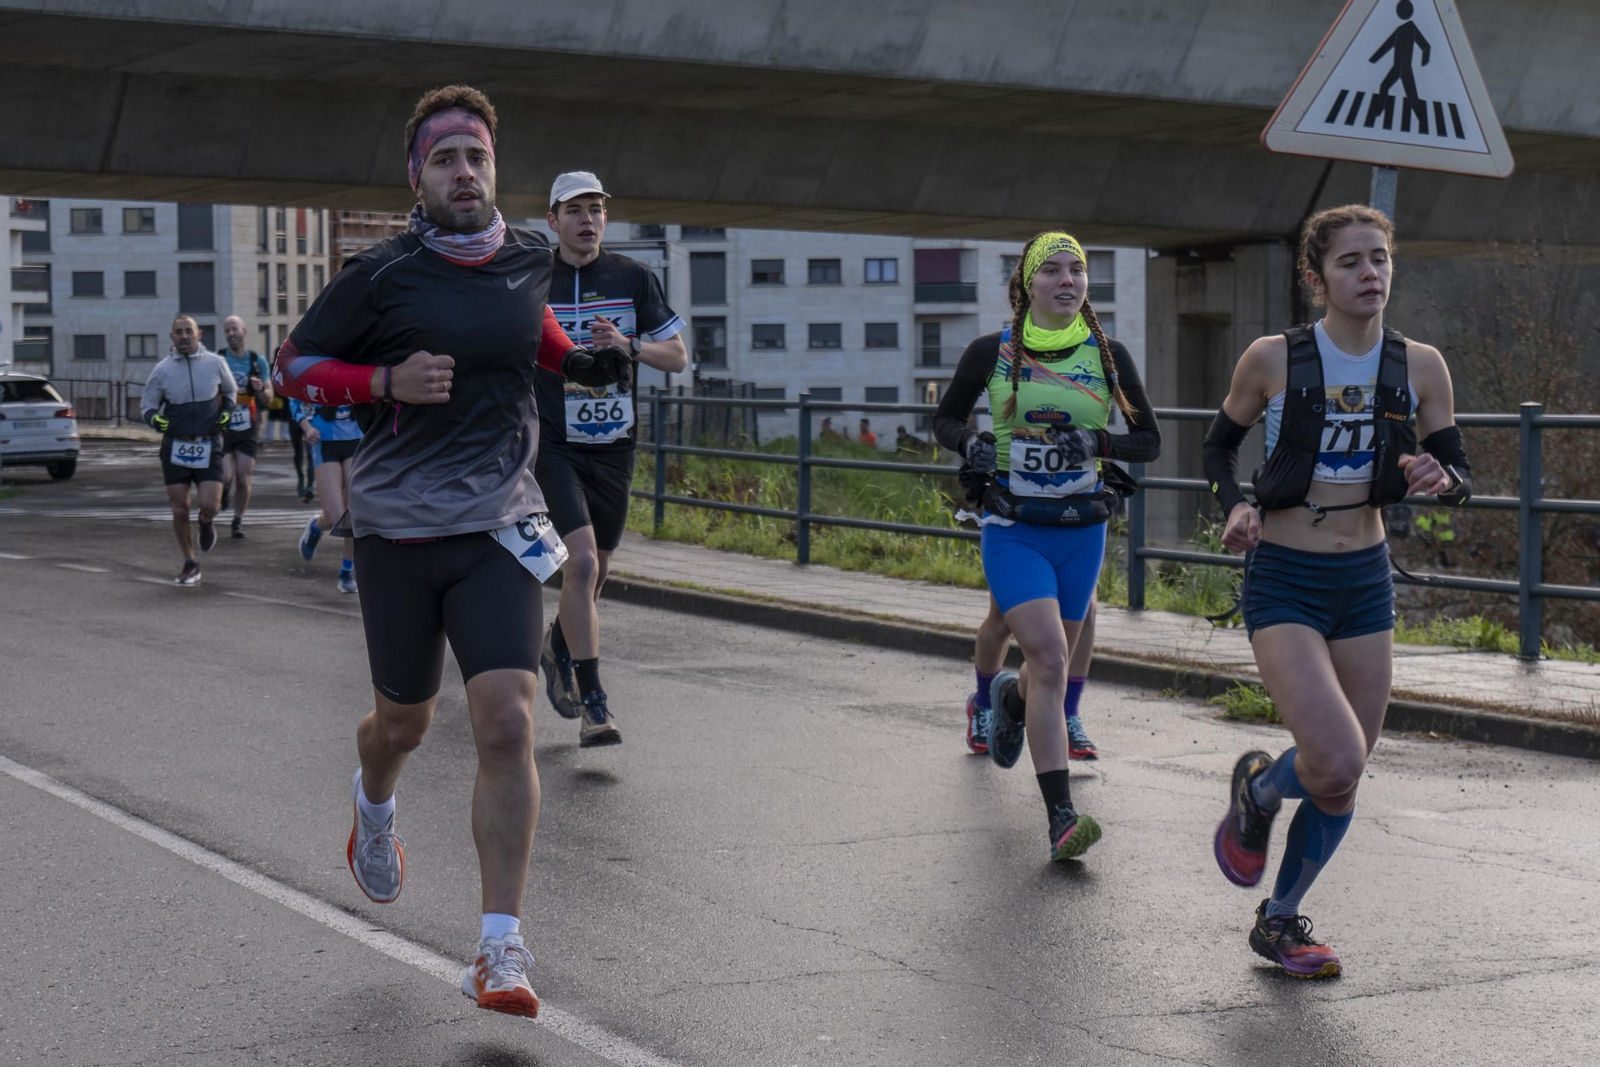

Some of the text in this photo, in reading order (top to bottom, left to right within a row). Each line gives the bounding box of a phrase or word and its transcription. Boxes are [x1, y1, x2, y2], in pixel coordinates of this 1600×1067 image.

[557, 316, 623, 332] REK
[232, 413, 244, 423] 11
[576, 401, 624, 423] 656
[178, 445, 204, 457] 649
